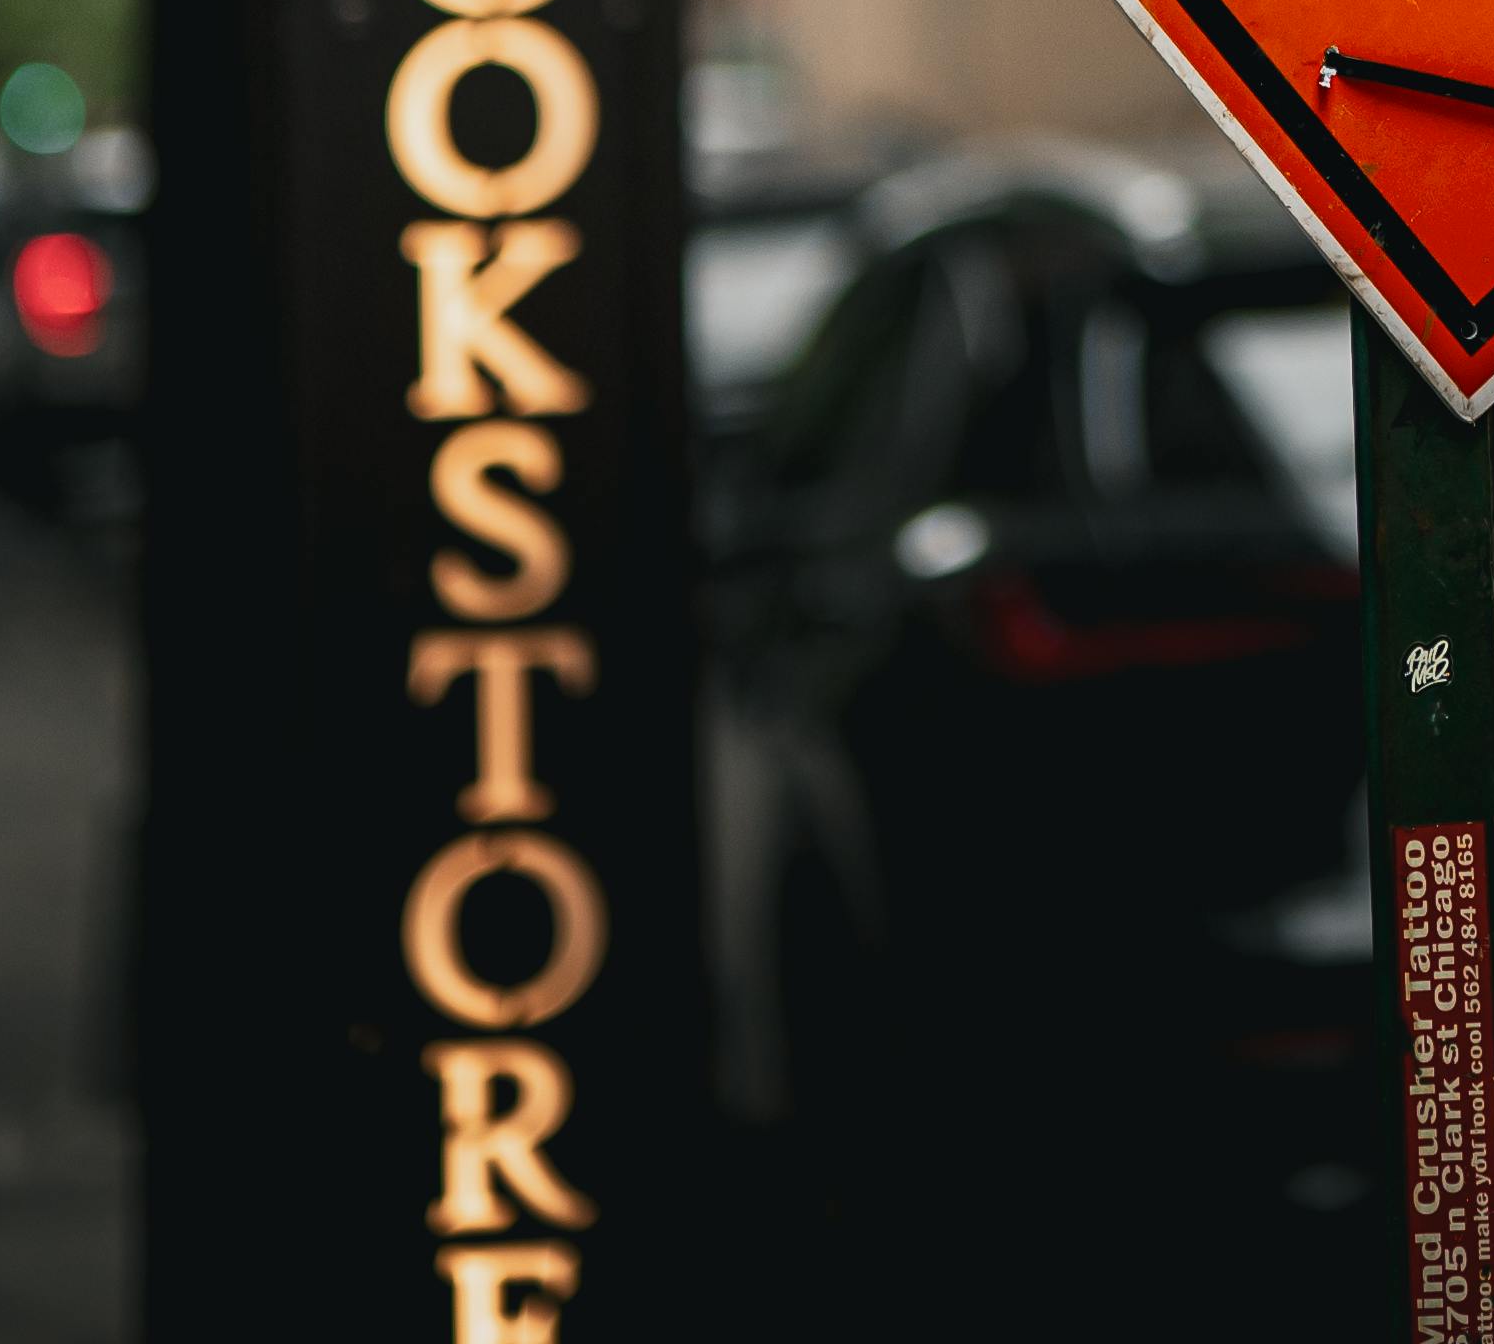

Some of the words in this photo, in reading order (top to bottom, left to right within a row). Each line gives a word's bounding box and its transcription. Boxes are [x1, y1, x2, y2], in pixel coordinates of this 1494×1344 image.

[1456, 833, 1476, 899] 8165
[1402, 839, 1431, 1002] Tattoo
[1431, 835, 1457, 1012] Chicago
[1459, 905, 1478, 957] 484
[1463, 964, 1481, 1014] 562
[1436, 1023, 1459, 1065] st
[1465, 1021, 1484, 1075] cool
[1409, 1011, 1441, 1215] Crusher
[1438, 1076, 1465, 1194] Clark
[1468, 1080, 1486, 1135] look
[1470, 1138, 1491, 1186] you
[1448, 1207, 1466, 1232] n
[1473, 1191, 1491, 1261] make
